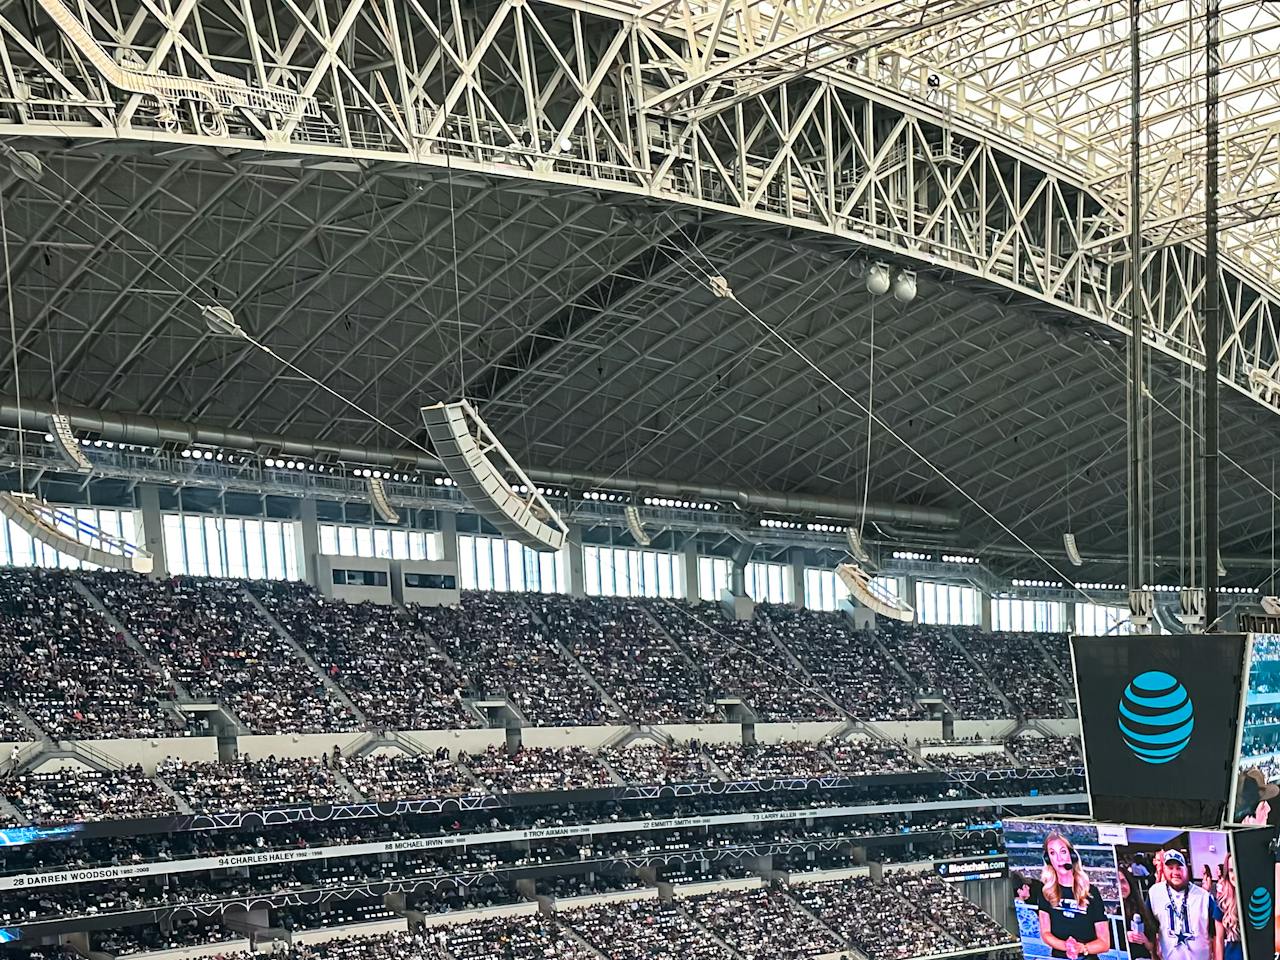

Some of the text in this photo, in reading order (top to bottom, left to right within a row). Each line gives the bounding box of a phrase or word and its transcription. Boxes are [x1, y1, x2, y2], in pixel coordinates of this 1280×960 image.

[231, 855, 267, 864] CHARLES
[270, 853, 294, 861] HALEY
[949, 861, 1005, 874] Blockchain.com
[27, 874, 68, 885] DARREN
[71, 870, 118, 880] WOODSON
